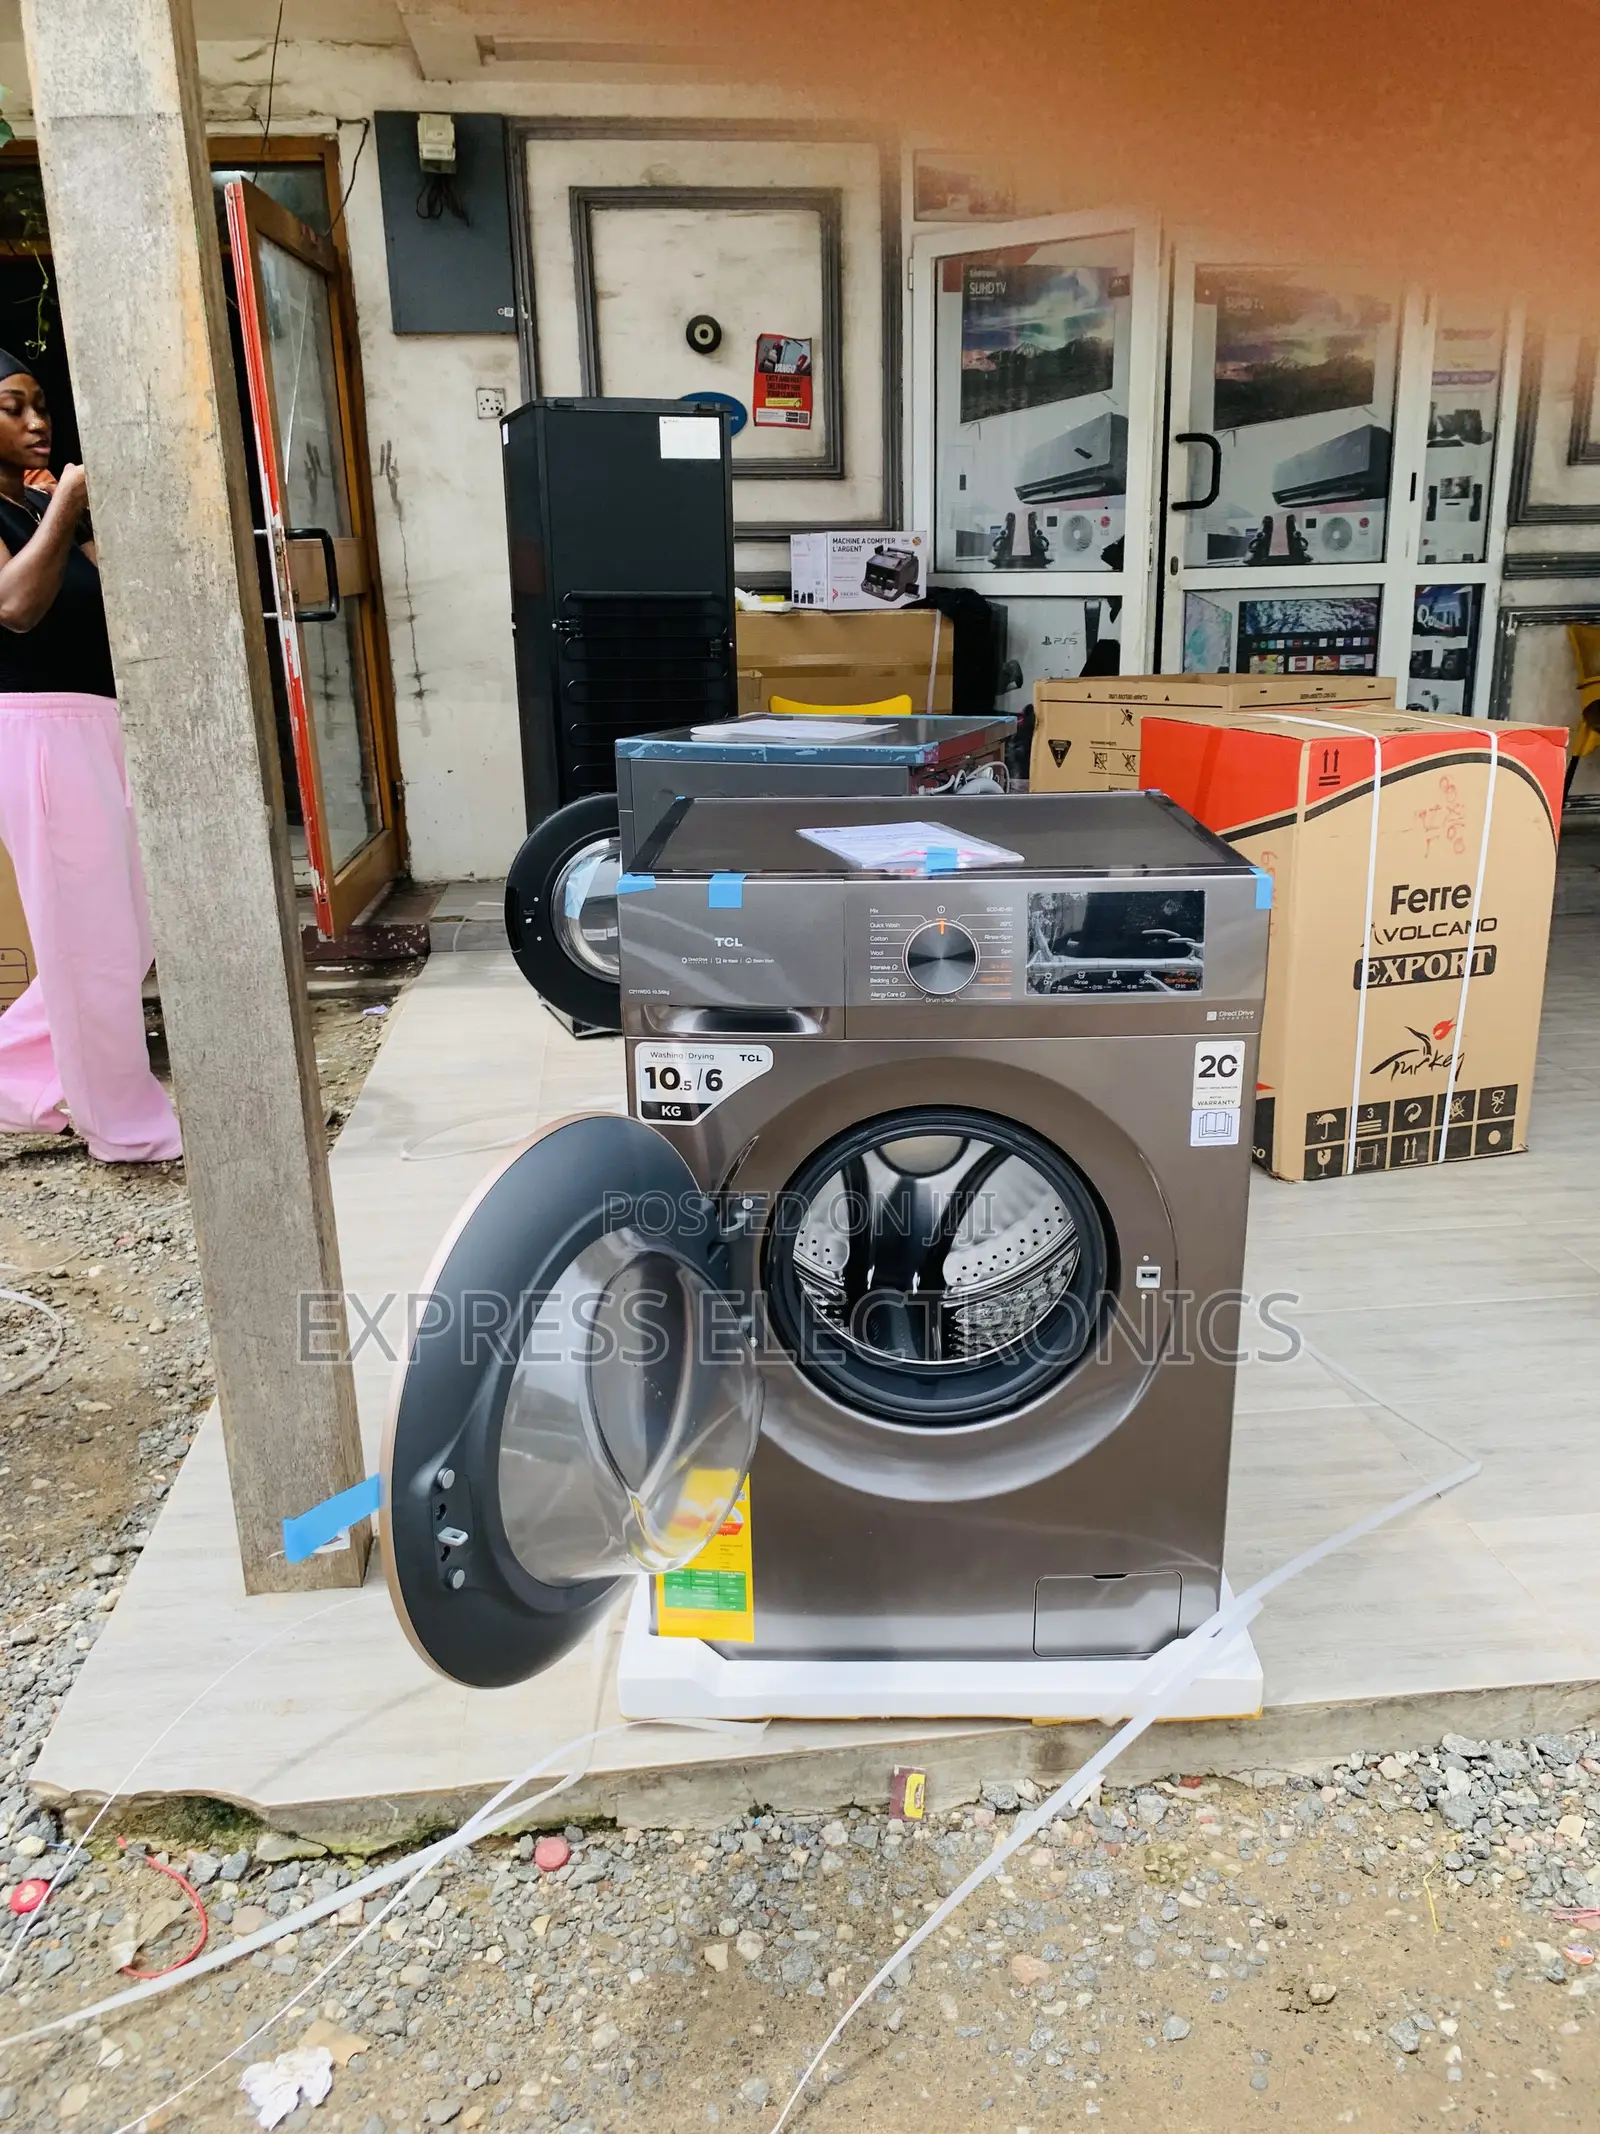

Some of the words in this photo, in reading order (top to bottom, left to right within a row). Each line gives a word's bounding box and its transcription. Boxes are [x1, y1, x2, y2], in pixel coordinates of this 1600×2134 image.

[969, 282, 994, 295] SUHD
[996, 281, 1007, 294] TV
[774, 363, 796, 373] YANGO
[867, 537, 896, 545] COMPTER
[1053, 637, 1078, 645] PS5
[1390, 884, 1472, 915] Ferre
[1382, 917, 1497, 942] VOLCANO
[714, 937, 743, 947] TCL
[1360, 948, 1493, 986] EXPORT
[650, 1051, 684, 1060] Washing
[688, 1052, 715, 1060] Drying
[739, 1054, 763, 1062] TCL
[661, 1105, 682, 1117] KG
[1366, 1107, 1375, 1119] 3
